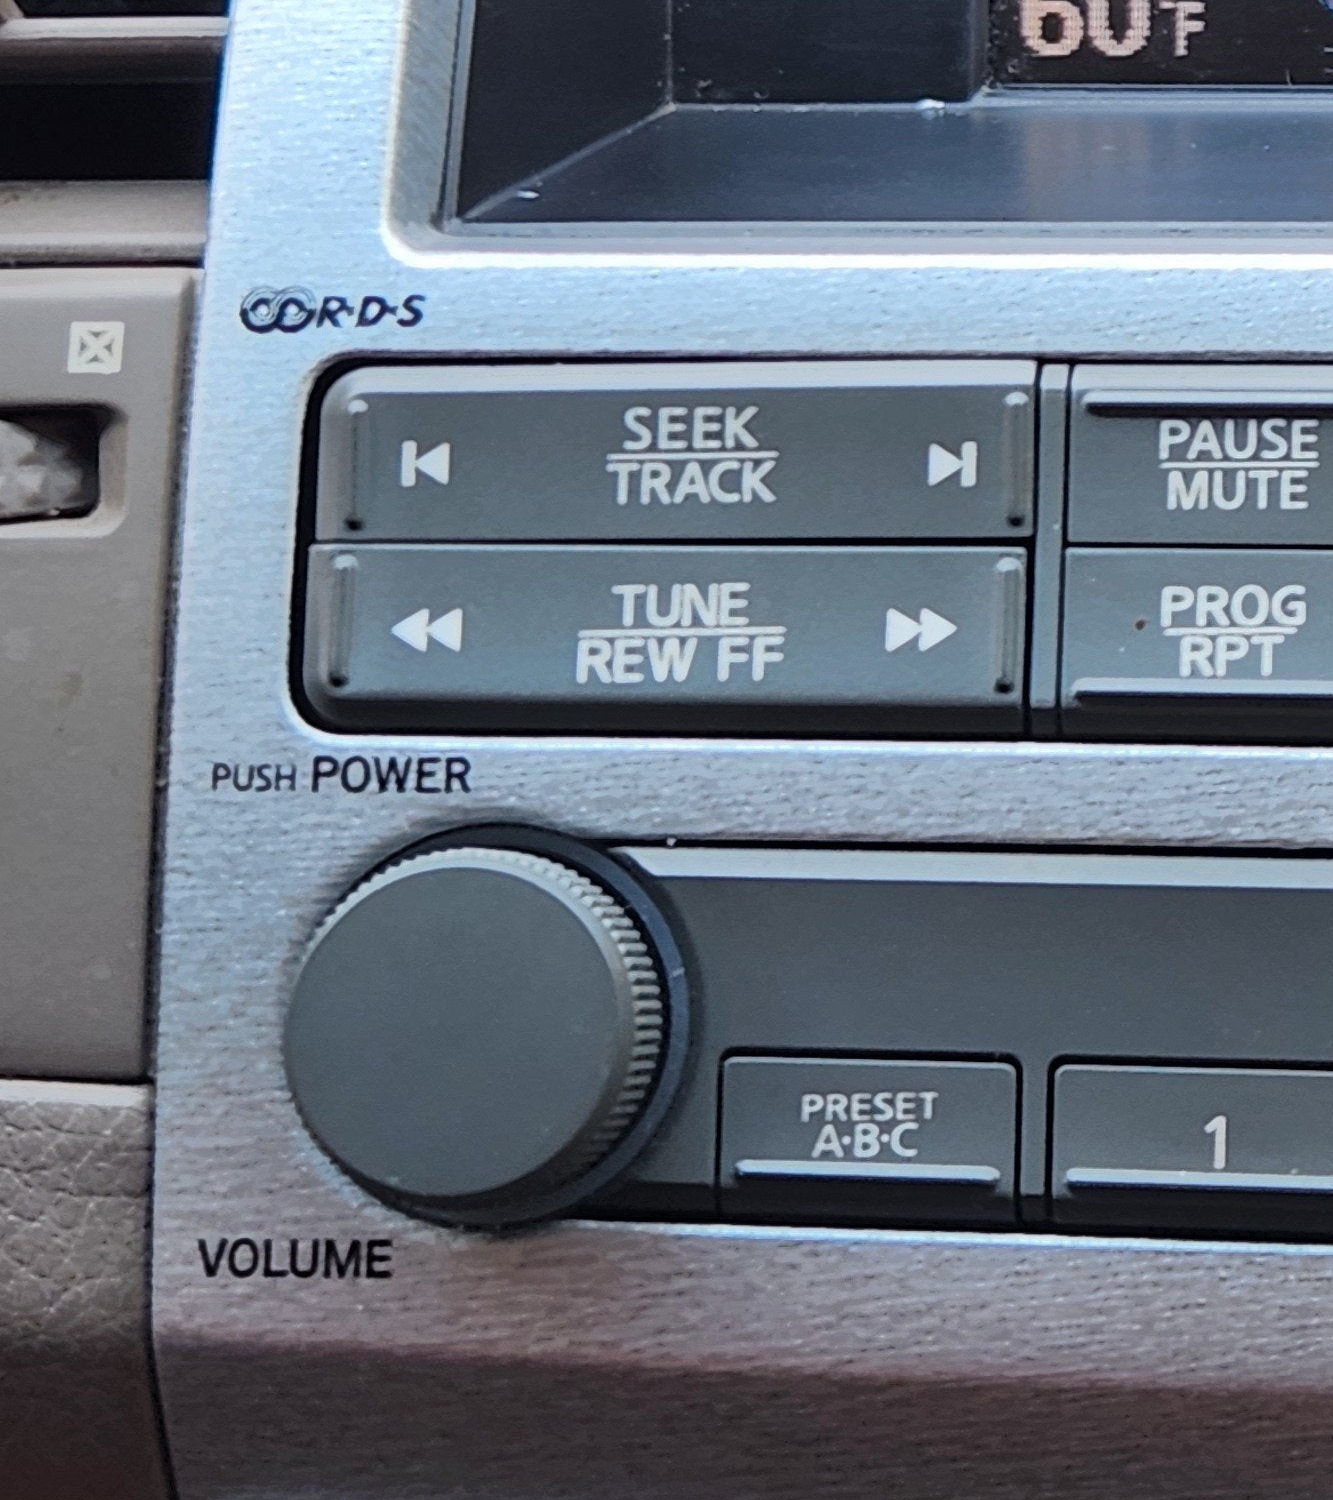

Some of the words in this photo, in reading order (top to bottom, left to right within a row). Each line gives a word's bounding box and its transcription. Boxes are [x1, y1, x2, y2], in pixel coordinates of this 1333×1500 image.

[622, 405, 759, 451] SEEK
[1158, 419, 1320, 461] PAUSE
[608, 460, 777, 504] TRACK
[1166, 470, 1309, 511] MUTE
[611, 582, 751, 628] TUNE
[1159, 585, 1307, 628] PROG
[576, 637, 697, 683] REW
[717, 637, 785, 682] FF
[1179, 635, 1286, 677] RPT
[210, 763, 296, 793] PUSH
[311, 755, 472, 793] POWER
[800, 1090, 940, 1123] PRESET
[1202, 1115, 1229, 1170] 1
[199, 1237, 394, 1279] VOLUME
